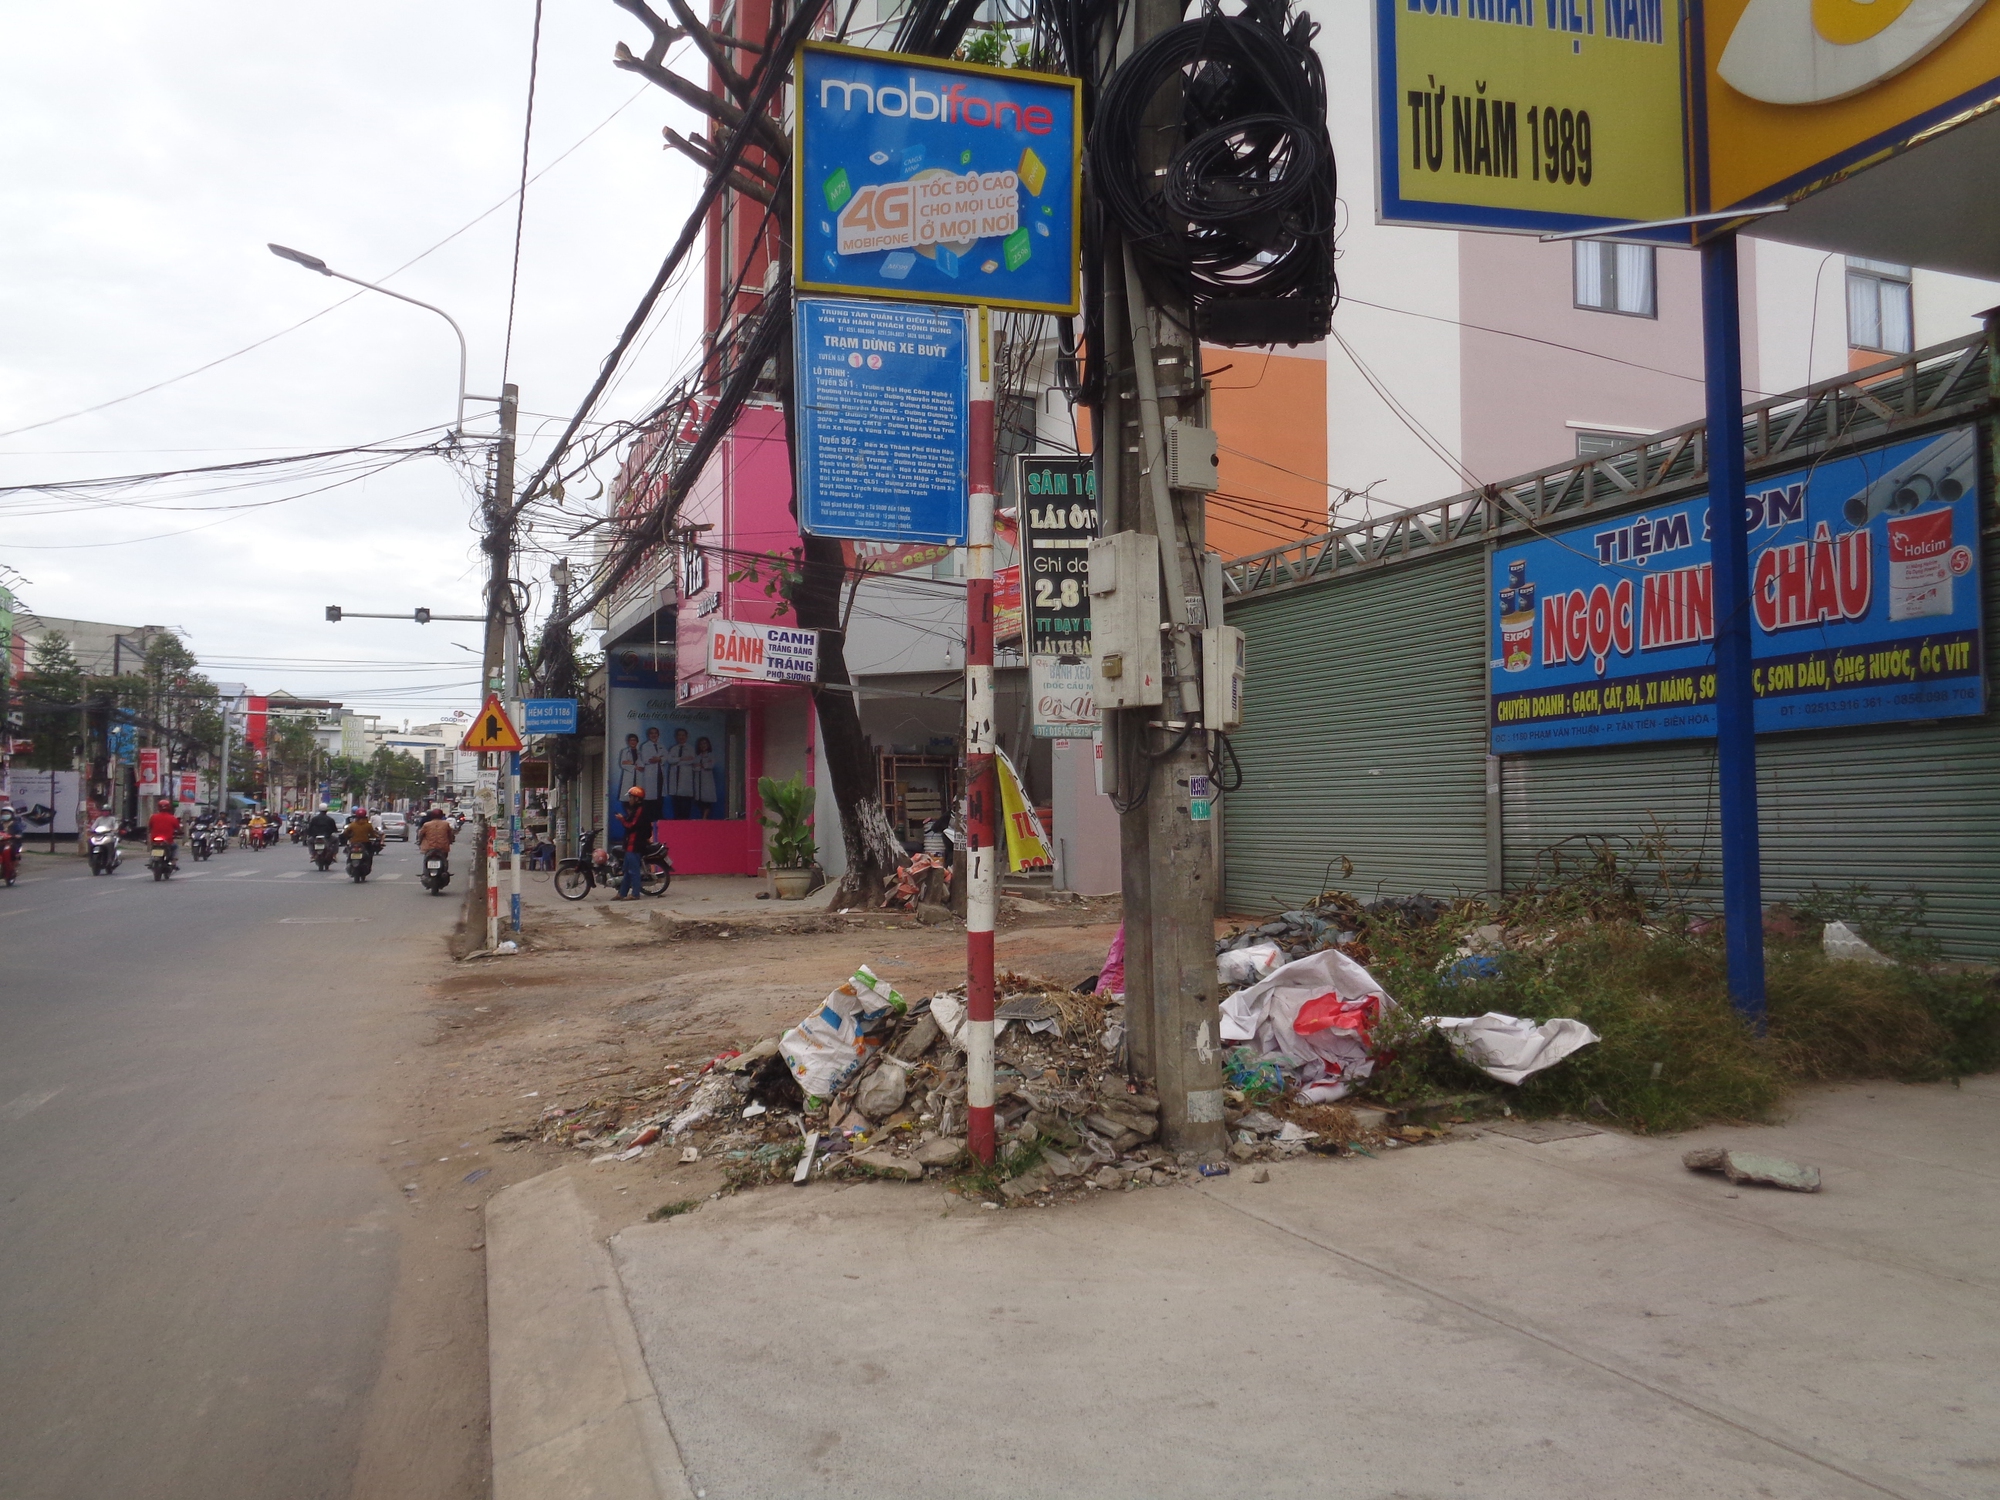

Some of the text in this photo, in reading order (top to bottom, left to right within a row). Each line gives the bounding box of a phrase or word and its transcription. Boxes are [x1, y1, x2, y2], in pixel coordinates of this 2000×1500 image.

[821, 78, 1052, 134] mobifone
[1407, 74, 1592, 187] TỪ NĂM 1989
[831, 182, 846, 199] M79
[920, 176, 1014, 198] TỐC ĐỘ CAO
[842, 187, 909, 231] 4G
[920, 194, 1014, 217] CHO MỌI LÚC
[920, 214, 1015, 241] Ở MỌI NƠI
[843, 233, 909, 250] MOBIFONE
[1012, 248, 1028, 262] 25%
[818, 316, 835, 324] VẬN
[877, 320, 904, 329] KHÁCH
[851, 310, 868, 318] TÂM
[824, 336, 947, 357] TRẠM DỪNG XE BUÝT
[871, 356, 880, 369] 2
[824, 367, 845, 377] TRÌNH
[816, 377, 836, 386] Tuyến
[839, 378, 848, 387] Số
[1028, 469, 1096, 500] SÂN TẬ
[1030, 504, 1098, 529] LÁI ÔT
[1594, 512, 1692, 566] TIỆM
[1905, 539, 1945, 557] Holcim
[1034, 556, 1062, 572] Ghi
[1035, 578, 1078, 611] 2,8
[1082, 581, 1088, 597] t
[1542, 521, 1872, 675] NGỌC MIN CHÂU
[1036, 618, 1051, 632] TT
[1055, 618, 1080, 636] DẠY
[1084, 618, 1092, 631] N
[1504, 629, 1530, 642] EXPO
[768, 630, 815, 645] CANH
[714, 630, 764, 665] BÁNH
[1058, 640, 1073, 654] XE
[767, 657, 813, 672] TRÁNG
[1498, 696, 1530, 722] CHUYÊN
[1532, 691, 1564, 717] DOANH
[1573, 692, 1601, 719] GẠCH,
[1604, 682, 1623, 711] CÁT,
[1647, 683, 1658, 703] XI
[1700, 672, 1717, 699] SƠ
[1768, 662, 1794, 691] SƠN
[1834, 650, 1866, 683] ỐNG
[1944, 637, 1970, 670] VÍT
[544, 706, 554, 716] SỐ
[1529, 729, 1551, 742] PHẠM
[1663, 715, 1685, 726] BIÊN
[1688, 714, 1708, 725] HÒA
